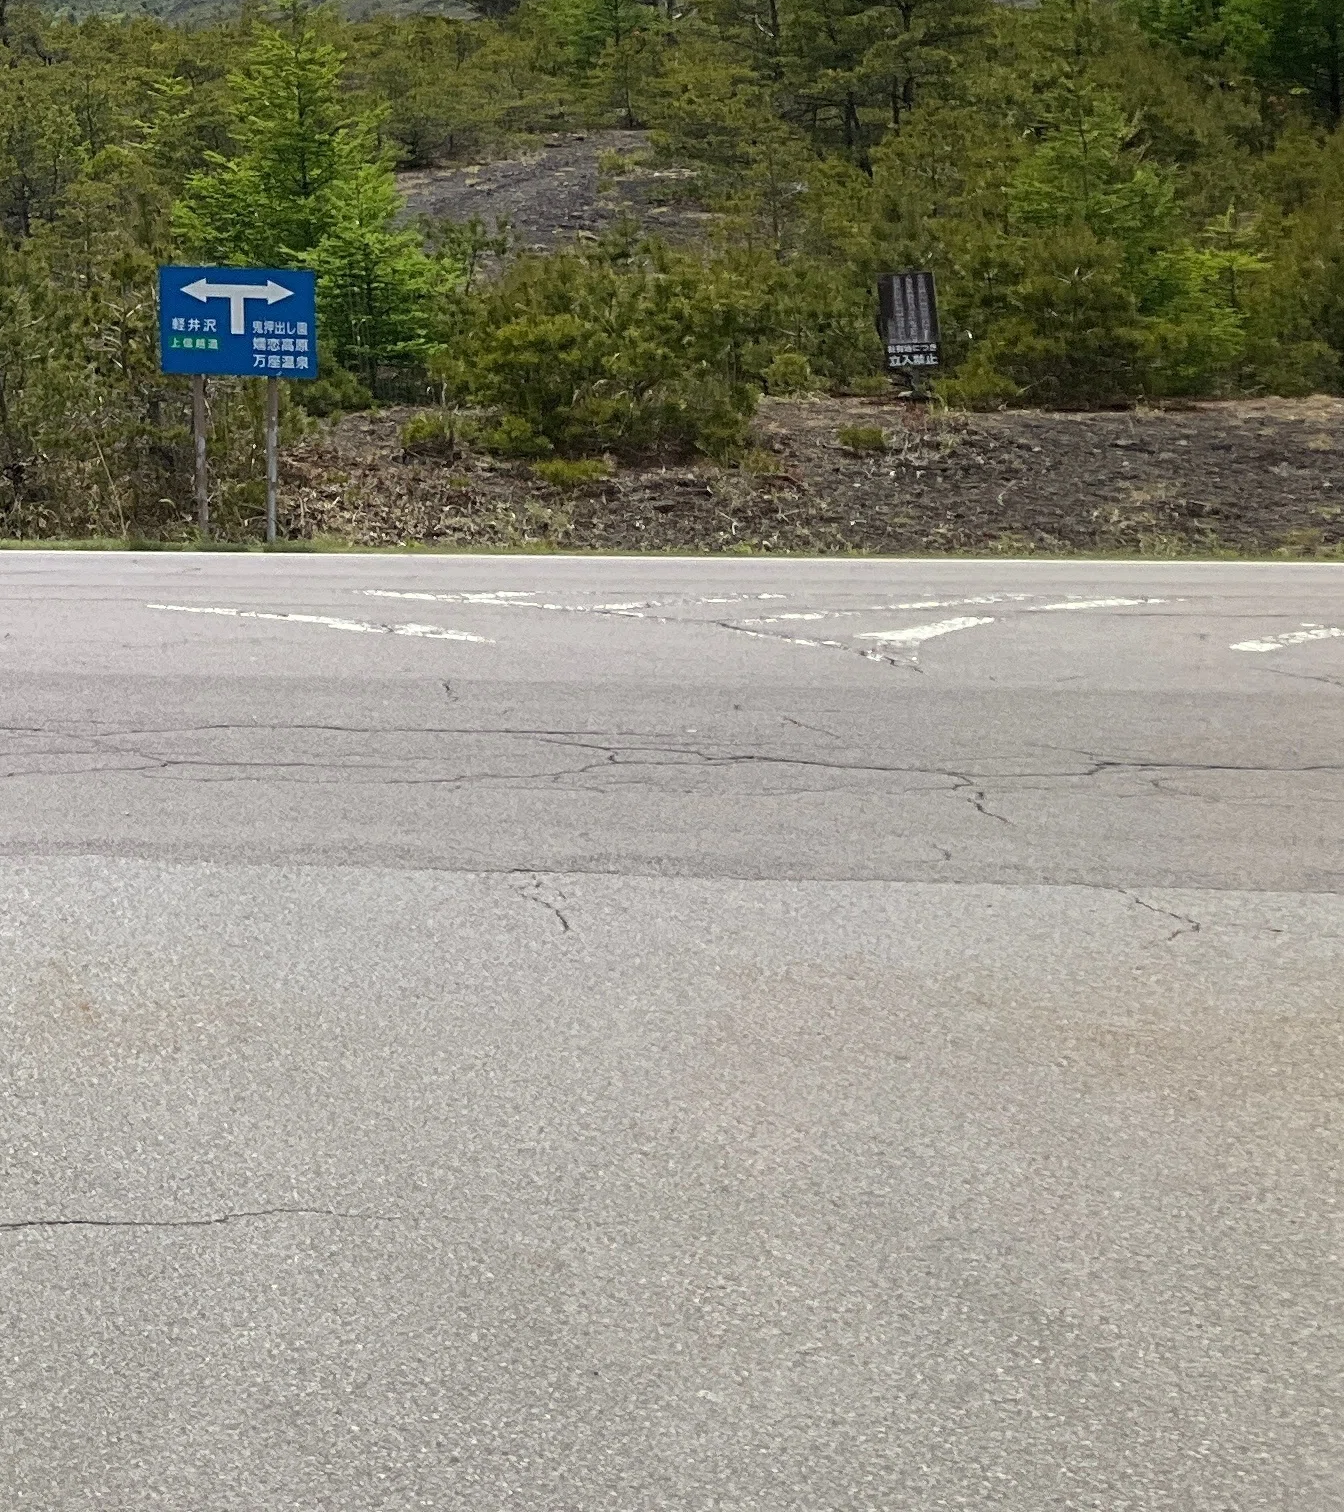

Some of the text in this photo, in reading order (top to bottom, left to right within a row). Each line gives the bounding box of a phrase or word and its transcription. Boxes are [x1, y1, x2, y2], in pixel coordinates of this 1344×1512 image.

[172, 317, 217, 333] 軽井沢
[252, 321, 308, 336] 鬼押出し園
[170, 338, 219, 350] 上信越道
[253, 338, 309, 352] 嬬恋高原
[253, 354, 309, 369] 万座温泉
[889, 354, 939, 367] 立入禁止
